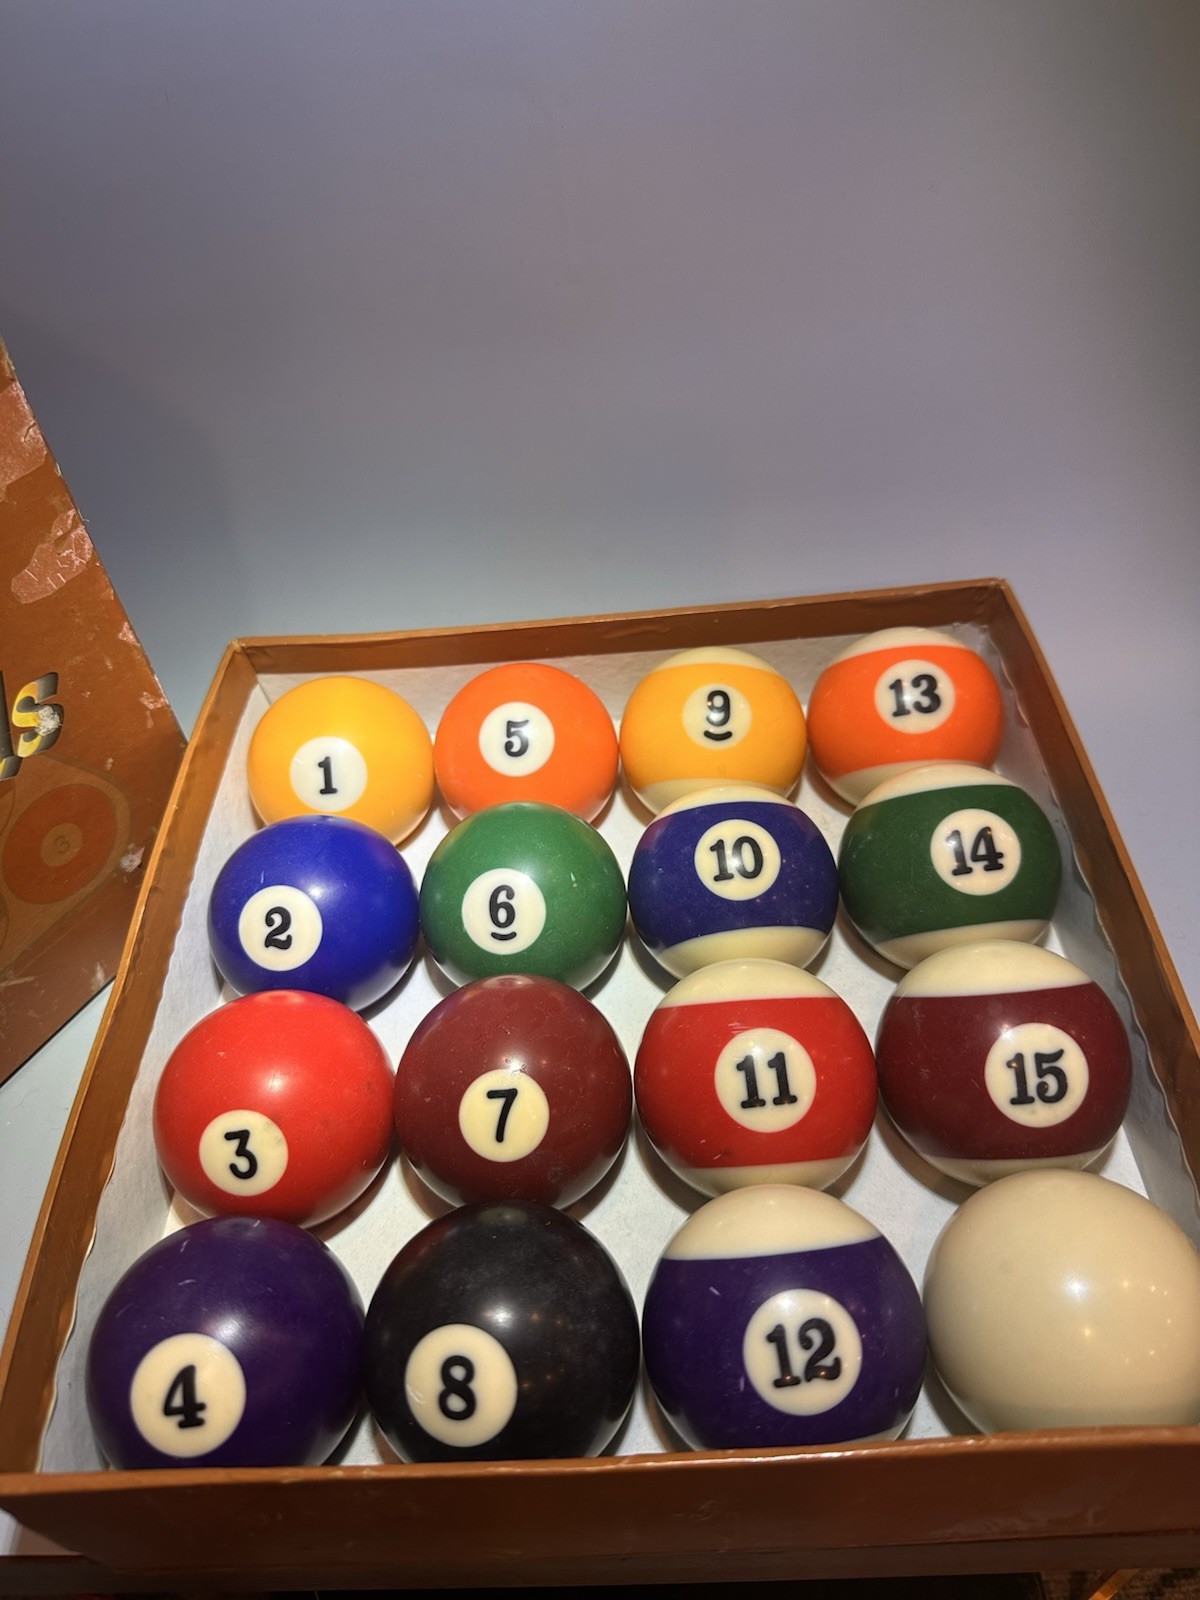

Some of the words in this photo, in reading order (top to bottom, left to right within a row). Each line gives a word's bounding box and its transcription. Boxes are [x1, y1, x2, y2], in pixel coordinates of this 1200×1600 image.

[704, 689, 733, 741] 9
[889, 674, 941, 717] 13
[504, 720, 529, 758] 5
[318, 757, 337, 795] 1
[710, 836, 763, 882] 10
[951, 827, 1004, 876] 14
[264, 907, 292, 950] 2
[489, 885, 517, 941] 6
[736, 1052, 798, 1109] 11
[1006, 1049, 1068, 1106] 15
[487, 1088, 518, 1143] 7
[224, 1129, 258, 1180] 3
[766, 1318, 842, 1389] 12
[162, 1365, 206, 1430] 4
[438, 1355, 477, 1422] 8
